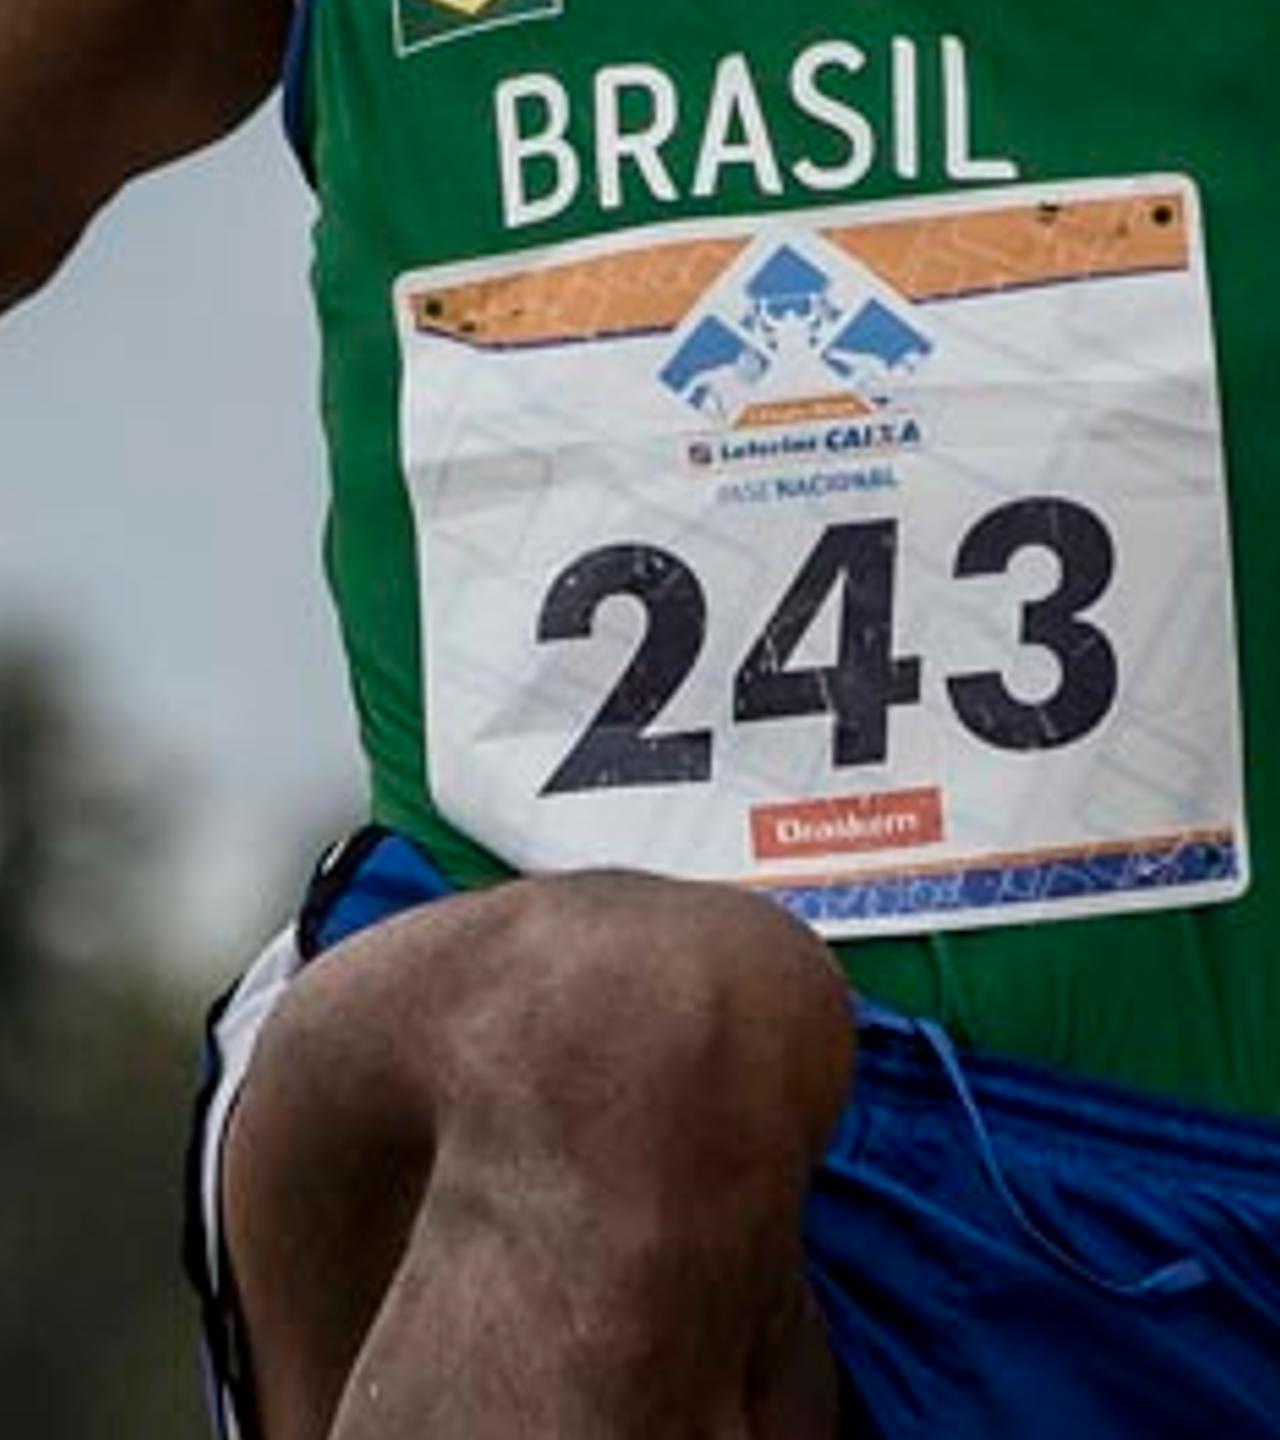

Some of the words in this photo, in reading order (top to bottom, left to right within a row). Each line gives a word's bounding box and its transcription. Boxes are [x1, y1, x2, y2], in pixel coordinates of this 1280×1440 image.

[494, 34, 1018, 229] BRASIL
[774, 464, 897, 500] NACIONAL
[825, 418, 920, 453] CAIXA
[535, 495, 1119, 799] 243
